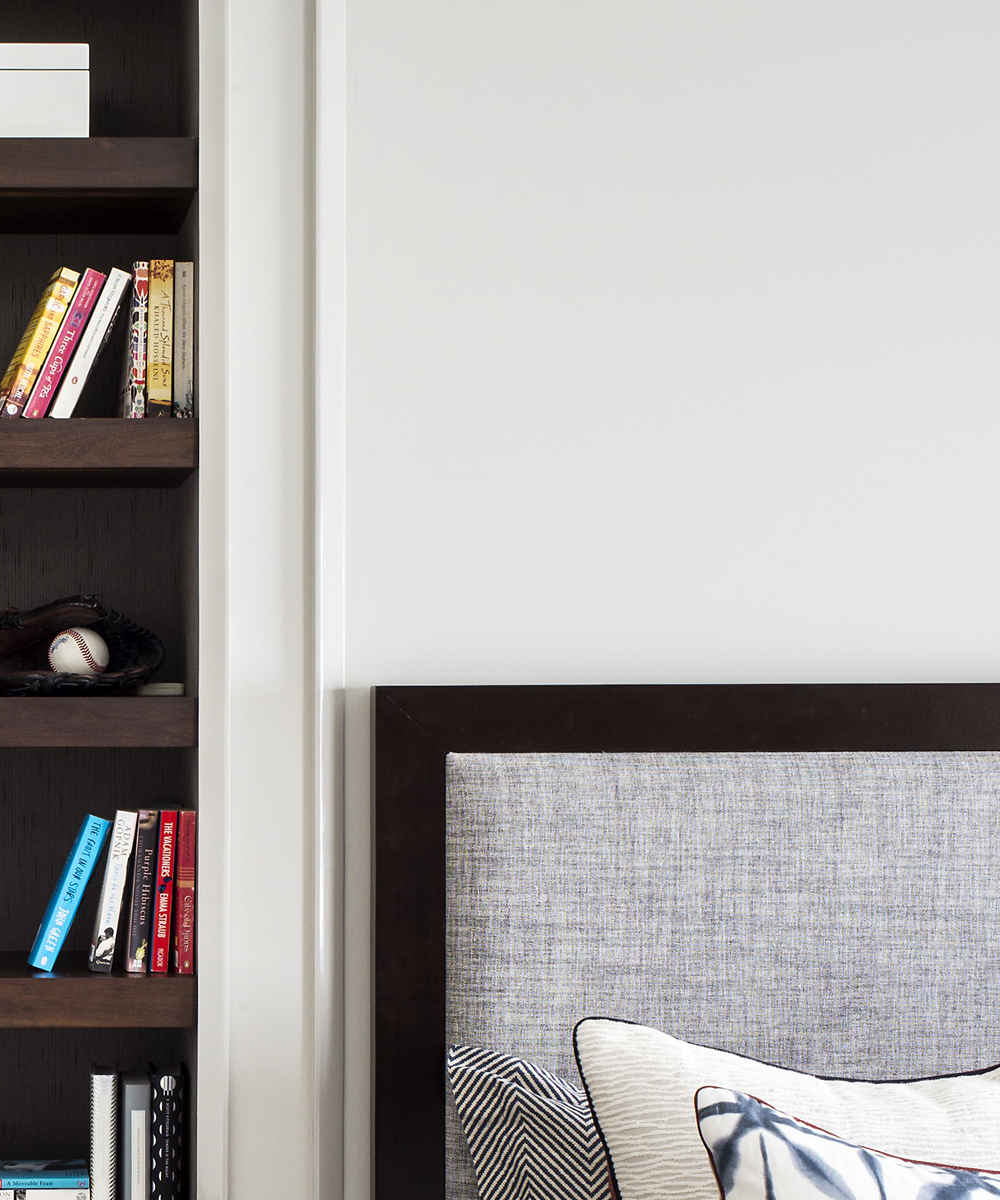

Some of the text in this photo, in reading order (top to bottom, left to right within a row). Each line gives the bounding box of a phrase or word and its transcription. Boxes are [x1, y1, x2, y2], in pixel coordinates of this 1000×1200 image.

[52, 284, 70, 310] GARLIC
[31, 320, 53, 359] SAPPHIRES
[159, 290, 171, 387] A Thousand Splendid Suns
[39, 330, 76, 398] Three Cups of Tea
[90, 822, 102, 836] THE
[111, 819, 125, 860] GOPNIK
[120, 825, 132, 856] ADAM
[81, 837, 96, 858] FAULT
[135, 835, 144, 882] CHIMAMANDA
[78, 858, 87, 868] IN
[63, 881, 79, 903] STARS
[139, 849, 153, 925] Purple Hibiscus
[157, 822, 173, 938] THE VACATIONERS EMMA STRAUB
[55, 906, 69, 926] JOHN
[45, 927, 61, 953] GREEN
[156, 948, 164, 967] PICADOR
